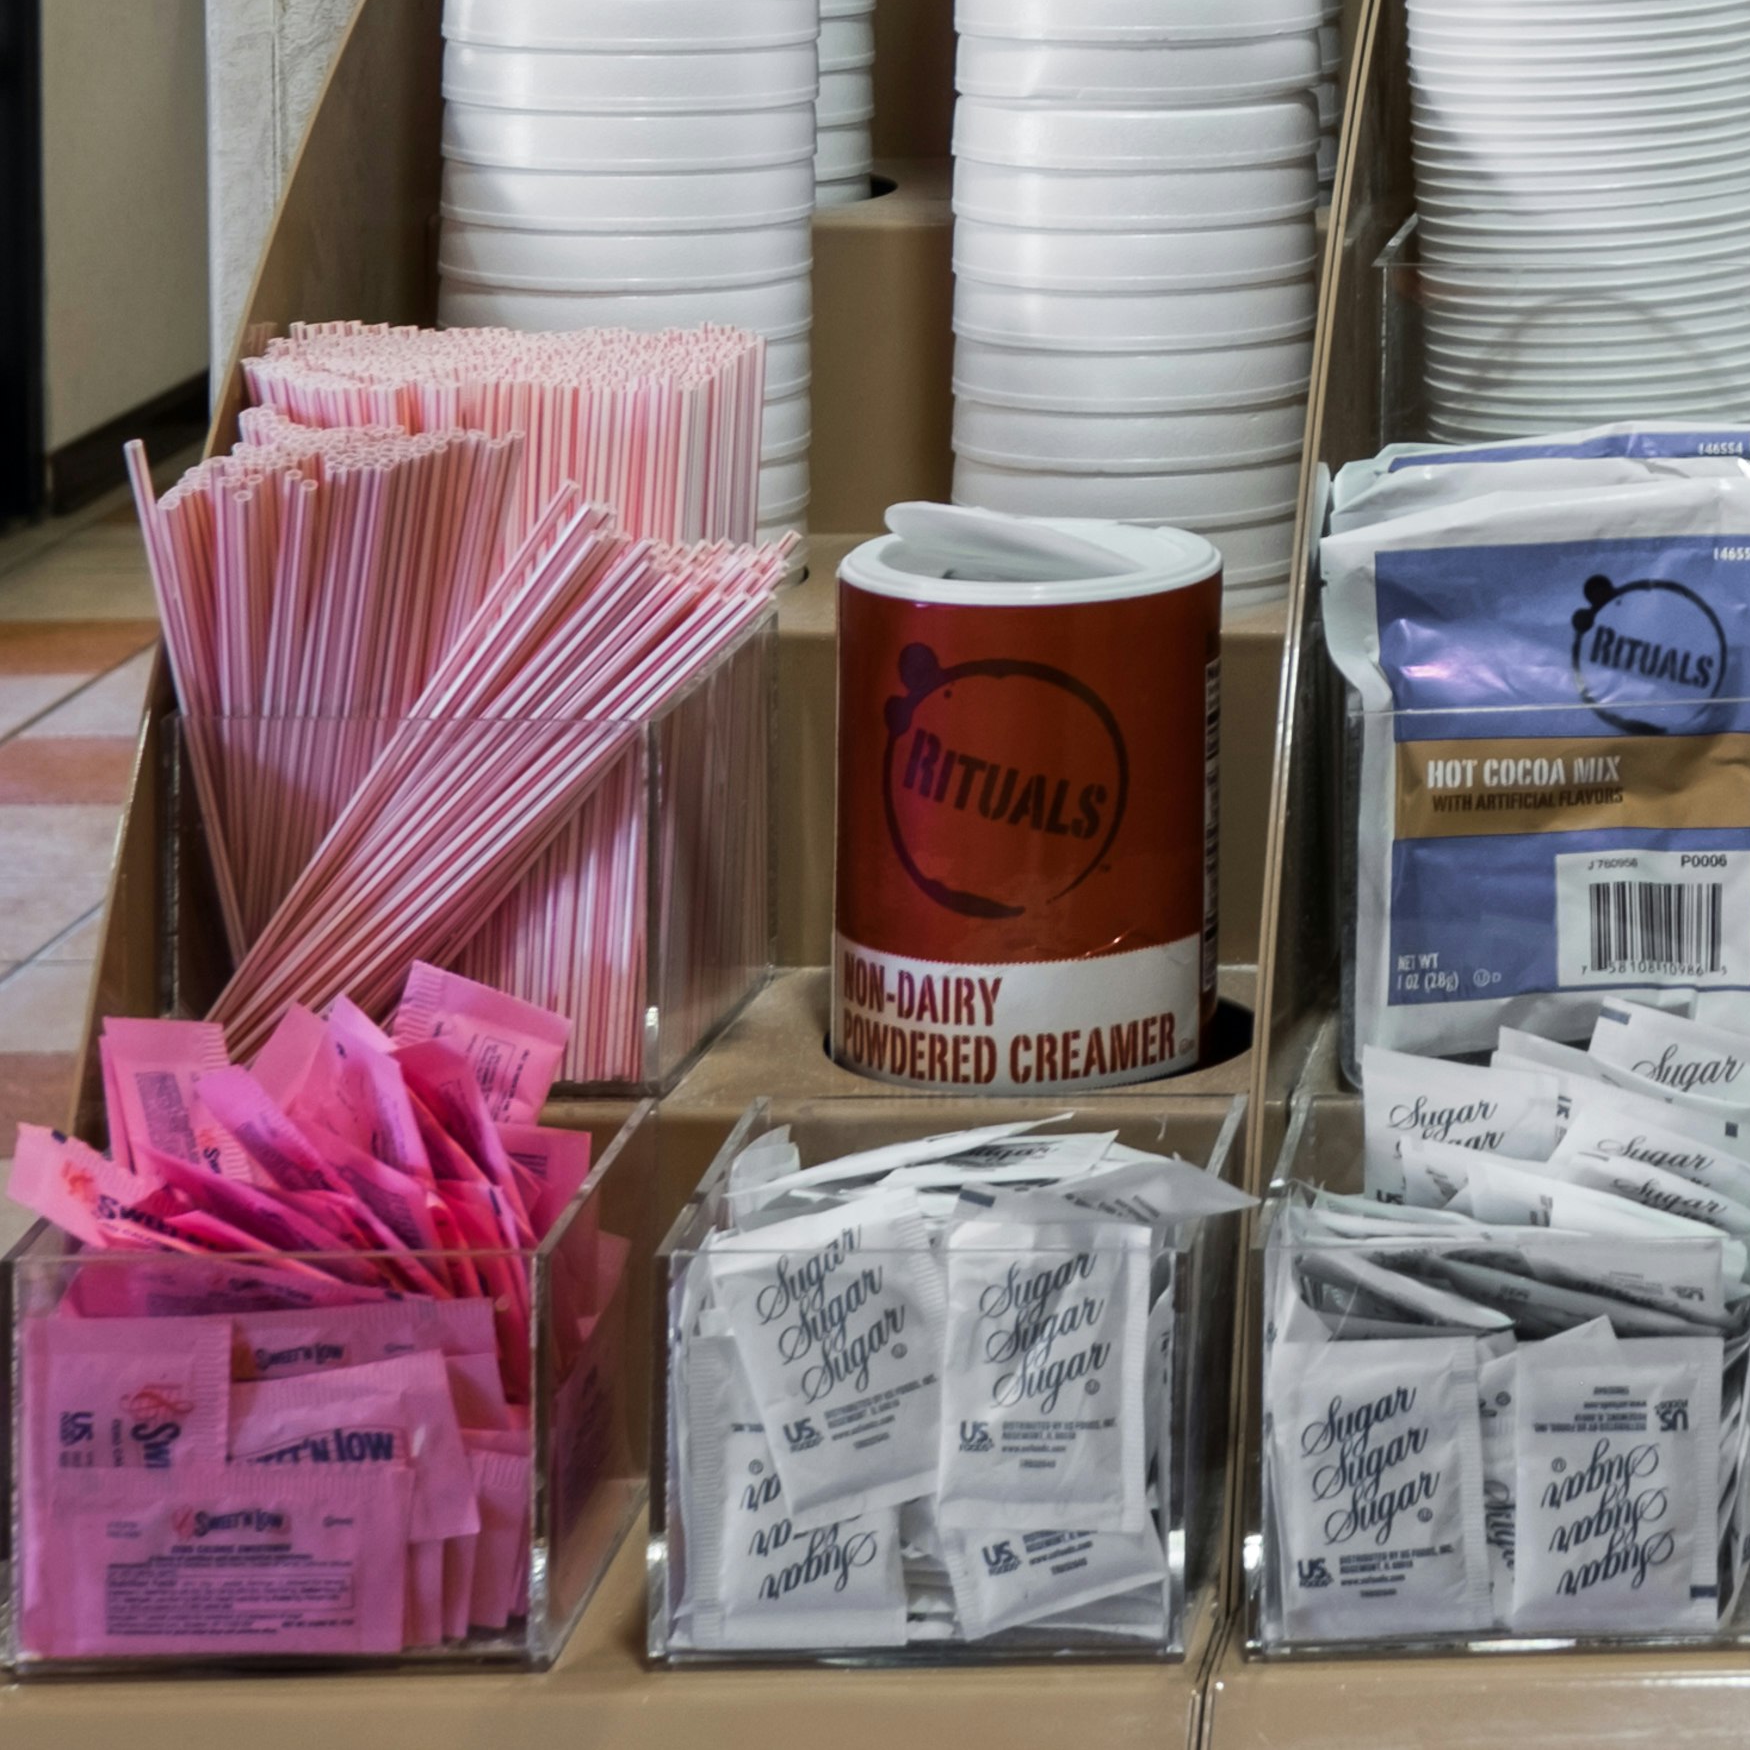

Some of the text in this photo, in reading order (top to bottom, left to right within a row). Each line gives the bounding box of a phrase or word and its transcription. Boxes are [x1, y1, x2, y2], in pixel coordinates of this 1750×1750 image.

[1698, 442, 1743, 455] 146554
[1589, 626, 1714, 691] RITUALS
[903, 728, 1108, 841] RITUALS
[1426, 755, 1621, 790] HOT COCOA MIX
[1432, 787, 1624, 813] WITH ARTIFICIAL FLAVORS
[1681, 854, 1727, 867] P0006
[844, 950, 1003, 1026] NON-DAIRY
[1405, 975, 1419, 989] OZ
[1424, 971, 1459, 991] (28g)
[1419, 953, 1438, 968] WT
[844, 1007, 1177, 1086] POWDERED CREAMER
[1631, 1044, 1745, 1093] Sugar
[1389, 1095, 1498, 1140] Sugar
[1597, 1136, 1715, 1173] Sugar
[756, 1224, 861, 1325] Sugar
[979, 1253, 1098, 1323] Sugar
[779, 1265, 884, 1366] Sugar
[985, 1298, 1105, 1368] Sugar
[802, 1304, 905, 1405] Sugar
[992, 1341, 1109, 1414] Sugar
[1302, 1386, 1417, 1458] Sugar
[1313, 1428, 1429, 1502] Sugar
[1541, 1438, 1660, 1509] Sugar
[1324, 1470, 1442, 1546] Sugar
[1549, 1483, 1669, 1553] Sugar
[759, 1524, 879, 1600] Sugar
[1557, 1527, 1675, 1596] Sugar
